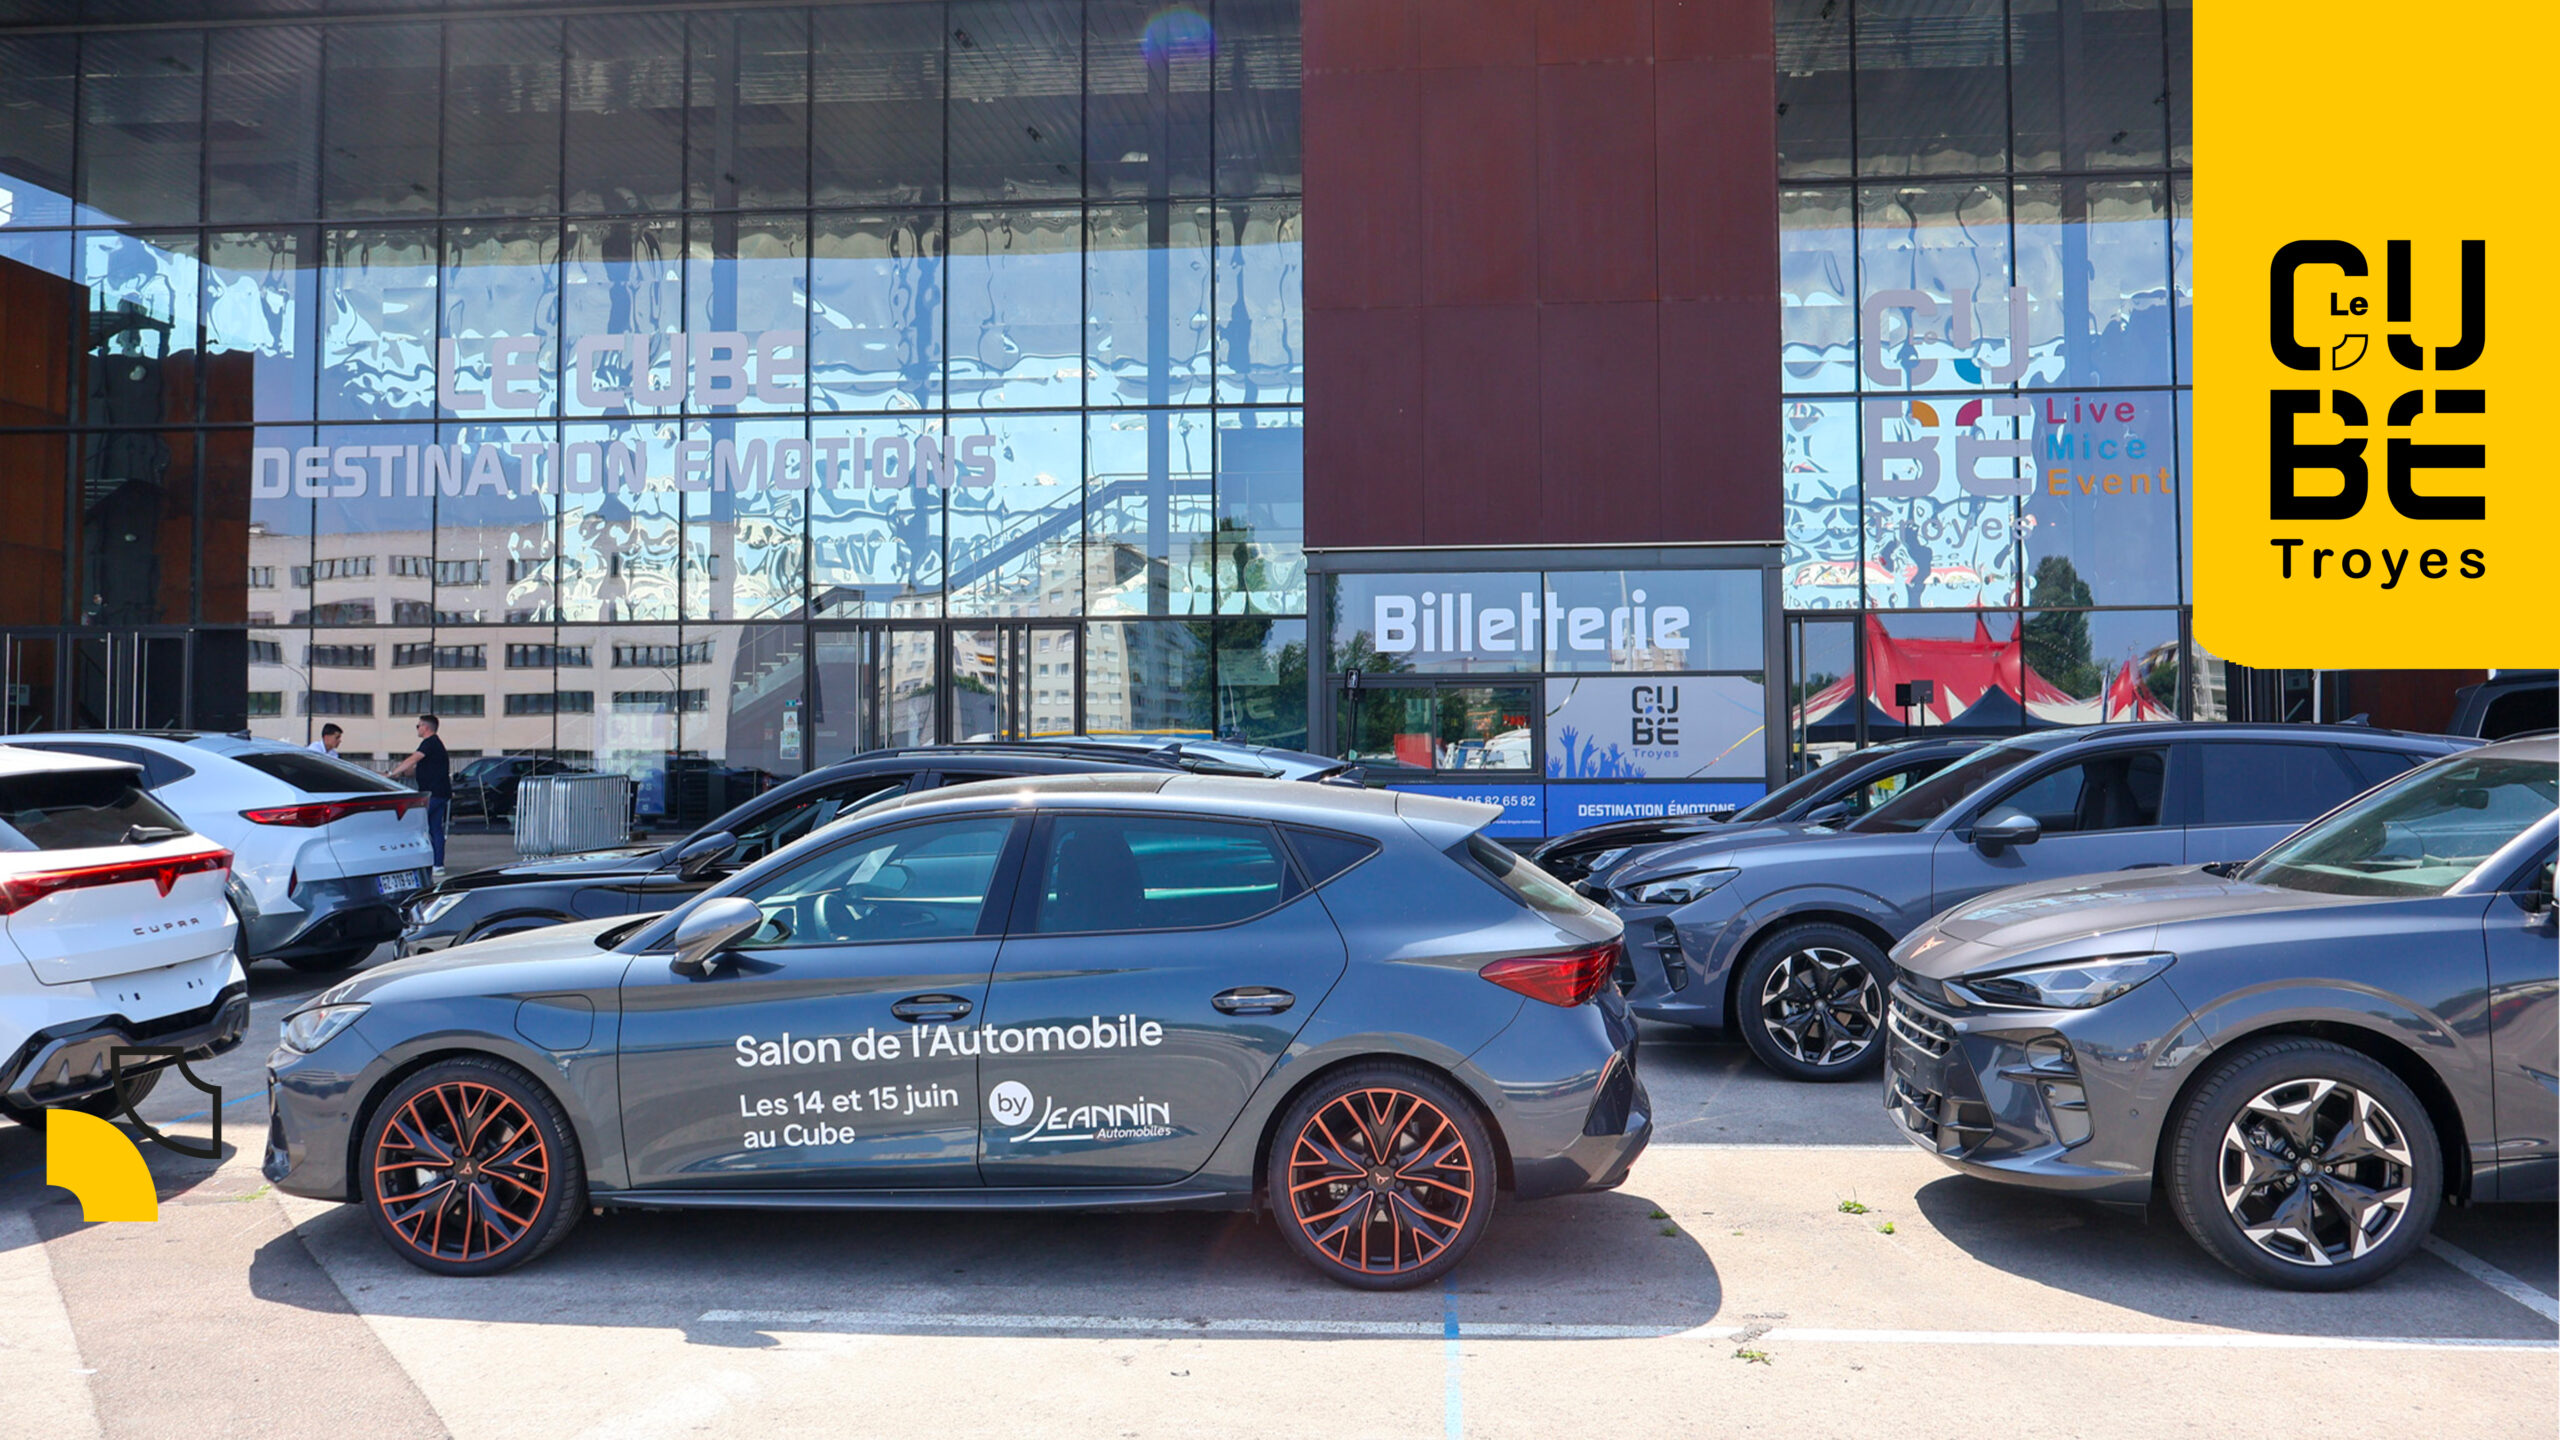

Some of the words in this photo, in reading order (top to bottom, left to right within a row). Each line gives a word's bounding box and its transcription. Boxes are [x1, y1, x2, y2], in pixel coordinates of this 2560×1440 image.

[439, 334, 542, 411] LE
[576, 331, 806, 409] CUBE
[2046, 397, 2135, 424] Live
[2047, 433, 2148, 461] Mice
[252, 440, 646, 499] DESTINATION
[2048, 467, 2173, 496] Event
[1867, 511, 2032, 549] Troyes
[1374, 589, 1690, 653] Billetterie
[1633, 748, 1679, 760] Troyes
[1484, 795, 1500, 805] 82
[1502, 795, 1518, 806] 65
[1520, 795, 1536, 806] 82
[1578, 804, 1663, 817] DESTINATION
[133, 917, 200, 935] CUPRA
[735, 1034, 841, 1067] Salon
[852, 1027, 900, 1060] de
[912, 1013, 1164, 1058] l'Automobile
[740, 1094, 788, 1118] Les
[793, 1090, 824, 1115] 14
[832, 1089, 862, 1112] et
[868, 1087, 898, 1110] 15
[904, 1083, 959, 1116] juin
[997, 1090, 1028, 1117] by
[743, 1128, 778, 1149] au
[783, 1121, 856, 1147] Cube
[1097, 1127, 1171, 1140] Automobiles
